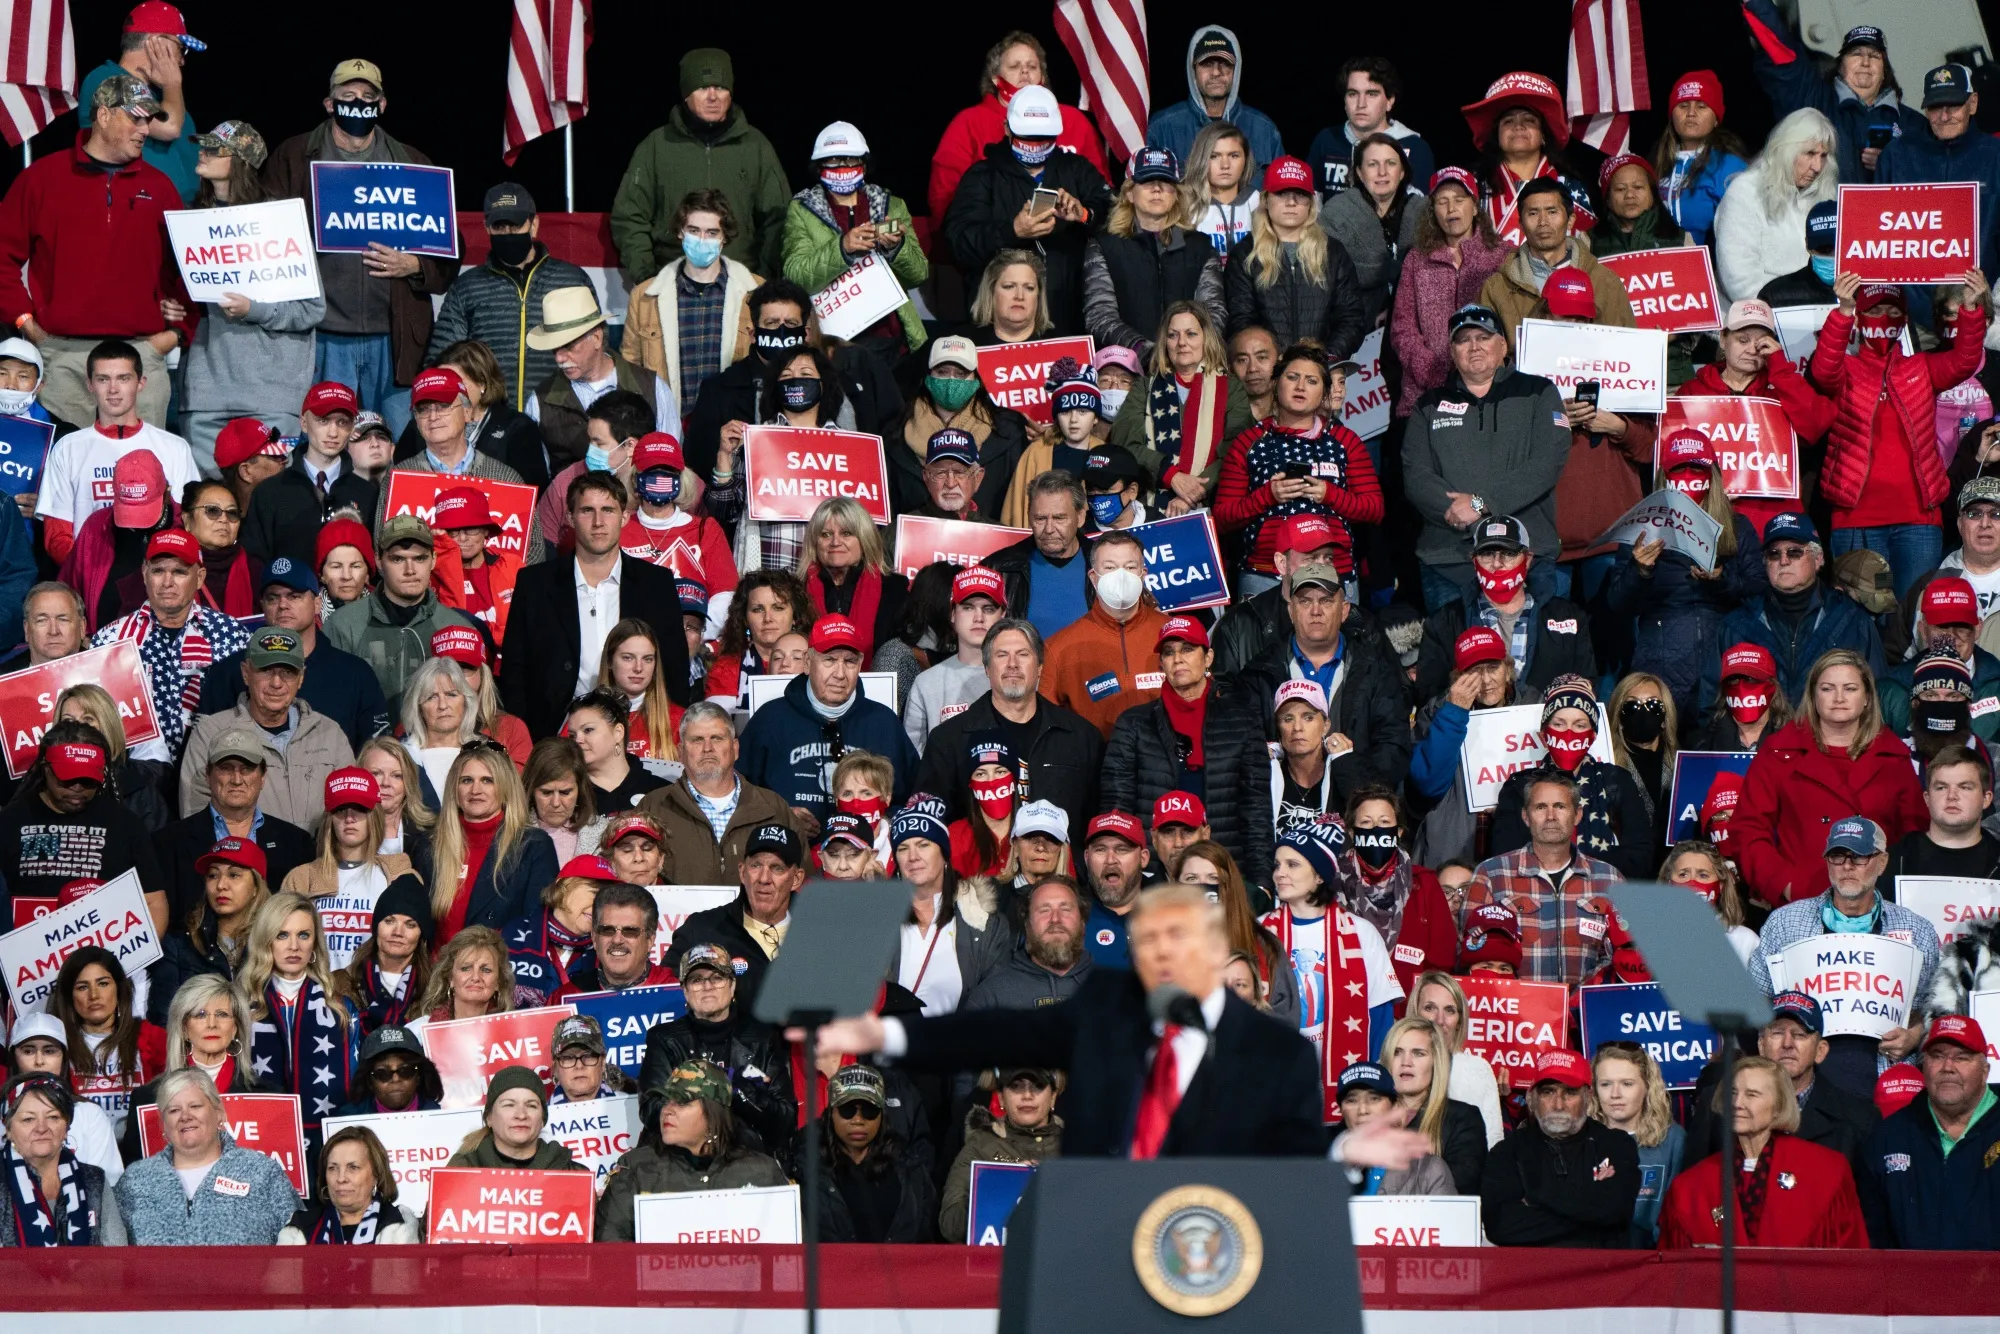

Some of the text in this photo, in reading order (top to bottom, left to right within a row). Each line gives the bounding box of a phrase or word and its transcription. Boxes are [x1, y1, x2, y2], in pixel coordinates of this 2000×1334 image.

[1509, 74, 1553, 93] AMERICA
[1486, 83, 1552, 100] GREAT AGAIN
[338, 104, 380, 119] MAGA
[1018, 141, 1050, 152] TRUMP
[1020, 155, 1046, 164] 2020
[1144, 152, 1168, 160] TRUMP
[825, 168, 859, 180] TRUMP
[1277, 166, 1307, 178] AMERICA
[1281, 172, 1304, 181] GREAT
[354, 186, 416, 206] SAVE
[830, 184, 855, 194] 2020
[325, 211, 446, 235] AMERICA!
[1879, 211, 1942, 232] SAVE
[209, 221, 261, 240] MAKE
[184, 237, 303, 266] AMERICA
[1846, 239, 1970, 259] AMERICA!
[189, 263, 307, 285] GREAT AGAIN
[1630, 292, 1709, 318] ERICA!
[1061, 394, 1095, 409] 2020
[1440, 402, 1466, 411] KELLY
[1697, 423, 1760, 442] SAVE
[932, 435, 969, 448] TRUMP
[1671, 438, 1704, 450] Trump
[787, 451, 849, 472] SAVE
[120, 482, 148, 494] Trump
[758, 478, 878, 501] AMERICA!
[1666, 479, 1710, 492] MAGA
[396, 505, 523, 533] AMCA
[956, 567, 1001, 582] MAKE AMERICA
[1145, 563, 1210, 592] RICA!
[959, 577, 997, 589] GREAT AGAIN
[432, 630, 479, 644] MAKE AMERICA
[436, 641, 476, 653] GREAT AGAIN
[1088, 677, 1119, 694] PERDUE
[1136, 673, 1165, 684] KELLY
[1280, 682, 1317, 695] TRUMP
[1726, 694, 1768, 708] MAGA
[1970, 699, 1996, 713] KELLY
[941, 704, 968, 716] KELLY
[970, 743, 1008, 755] TRUMP
[1547, 734, 1590, 751] MAGA
[65, 746, 97, 759] Trump
[329, 777, 369, 788] MAKE AMERICA
[332, 783, 368, 793] GREAT AGAIN
[795, 793, 824, 803] SOUTH
[973, 782, 1015, 801] MAGA
[1161, 797, 1193, 813] USA
[828, 815, 859, 826] Trump
[20, 825, 107, 837] GET OVER IT!
[760, 826, 788, 839] USA
[893, 818, 930, 840] 2020
[1355, 834, 1398, 848] MAGA
[352, 898, 371, 910] ALL
[1477, 905, 1514, 919] TRUMP
[1485, 913, 1505, 921] 2020
[45, 909, 101, 946] MAKE
[322, 912, 371, 930] EGAL
[1581, 921, 1606, 934] KELLY
[326, 935, 363, 952] OTES
[1396, 946, 1424, 959] KELLY
[1817, 951, 1875, 967] MAKE
[1793, 971, 1904, 1003] AMERICA
[1851, 999, 1902, 1026] AGAIN
[1620, 1010, 1681, 1033] SAVE
[1467, 1019, 1557, 1047] ERICA
[473, 1036, 541, 1068] SAVE
[839, 1074, 878, 1086] TRUMP
[1883, 1080, 1899, 1088] MAKE
[1886, 1086, 1904, 1094] GREAT
[551, 1115, 611, 1136] MAKE
[571, 1132, 633, 1160] ERIC
[387, 1147, 450, 1164] EFEND
[216, 1178, 248, 1192] KELLY
[480, 1187, 543, 1206] MAKE
[436, 1208, 581, 1237] AMERICA
[1373, 1227, 1440, 1247] SAVE
